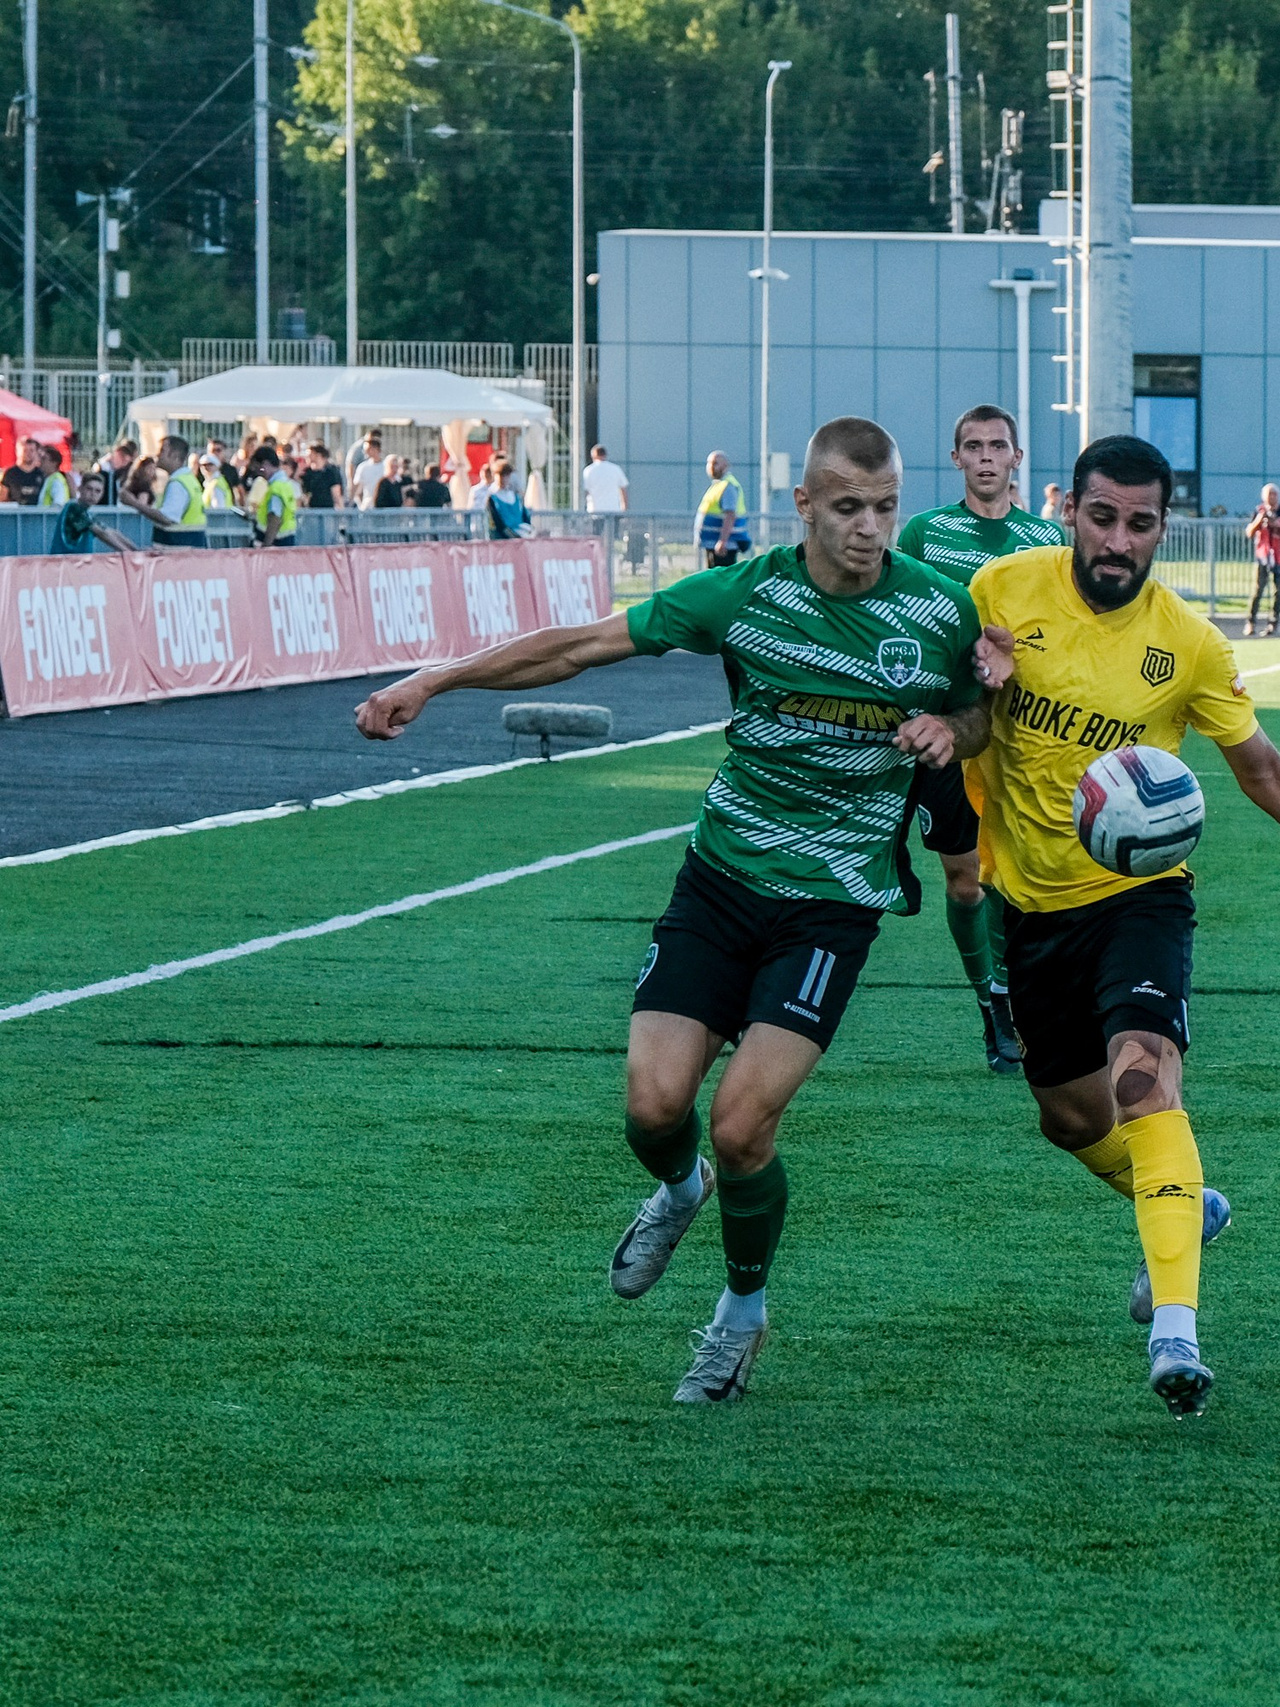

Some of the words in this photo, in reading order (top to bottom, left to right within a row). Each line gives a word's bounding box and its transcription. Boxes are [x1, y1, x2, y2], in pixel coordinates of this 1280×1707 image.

[18, 584, 111, 682] FONBET
[153, 578, 234, 668] FONBET
[267, 573, 339, 656] FONBET
[369, 567, 436, 646] FONBET
[1015, 638, 1049, 653] DEMIX
[1008, 684, 1083, 741] BROKE
[1077, 712, 1146, 751] BOYS
[798, 947, 836, 1007] 11
[1132, 986, 1167, 998] DEMIX
